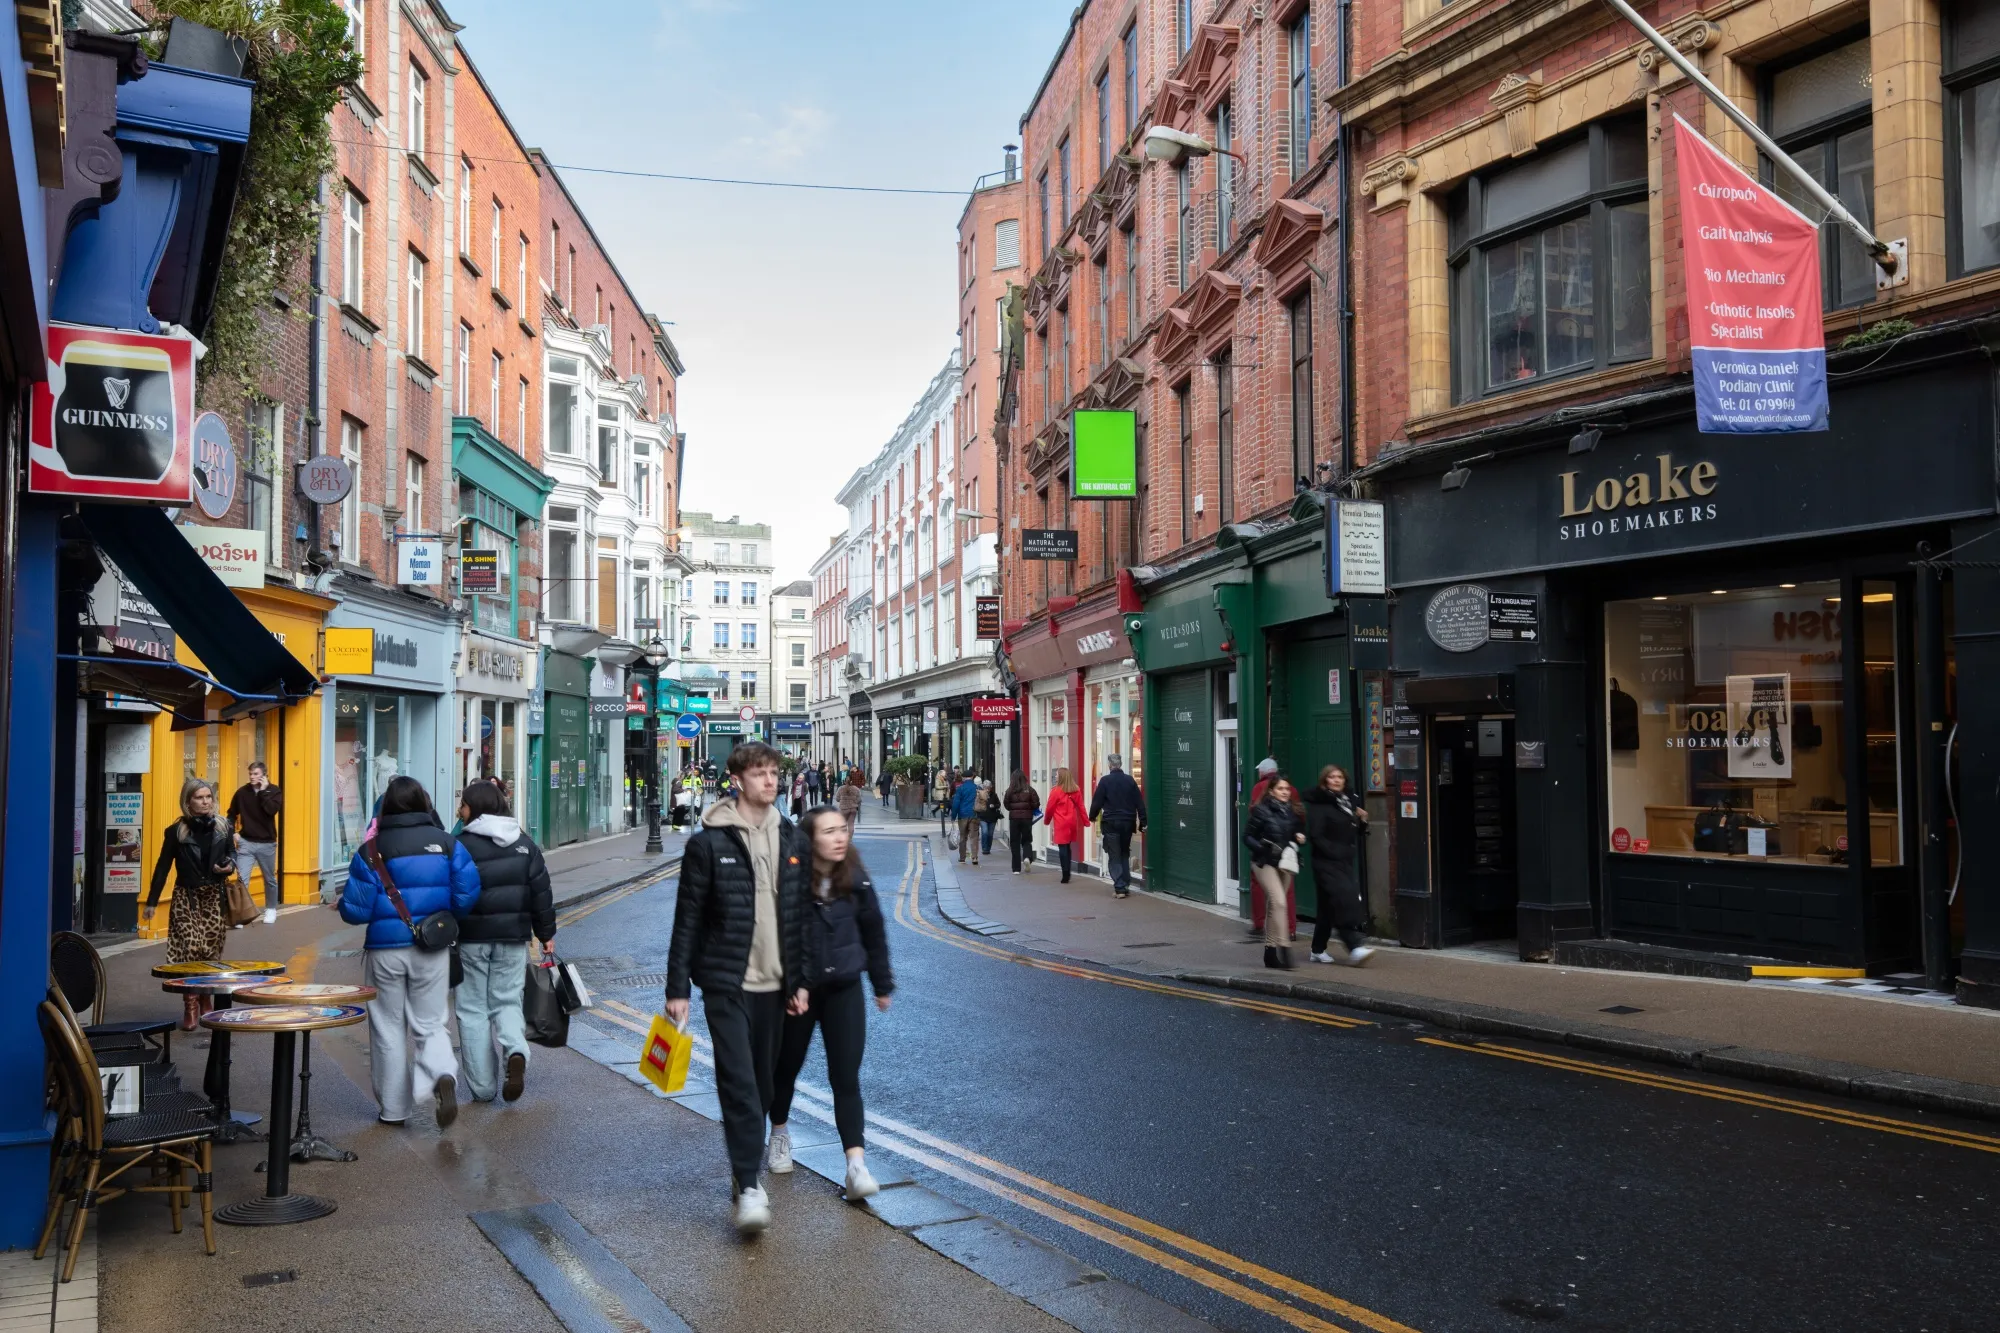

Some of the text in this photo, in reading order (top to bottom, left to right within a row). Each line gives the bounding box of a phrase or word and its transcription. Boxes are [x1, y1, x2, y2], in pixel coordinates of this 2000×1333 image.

[1700, 225, 1773, 245] Gait Analysis
[1725, 269, 1786, 285] Mechanics
[1710, 301, 1795, 319] Orthotic Insoles
[1711, 322, 1764, 340] Specialist
[1711, 361, 1799, 375] Veronica Daniels
[1719, 379, 1795, 395] Podiatry Clinic
[1718, 397, 1736, 410] Tel:
[1739, 398, 1750, 411] 01
[62, 408, 168, 432] GUINNESS
[200, 437, 229, 471] DRY
[311, 467, 341, 479] DRY
[1092, 482, 1118, 491] NATURAL
[1119, 482, 1132, 491] CUT
[1558, 453, 1719, 518] Loake
[1560, 503, 1717, 541] SHOEMAKERS
[413, 546, 428, 556] JoJo
[223, 565, 242, 573] Store
[409, 558, 431, 569] Maman
[412, 570, 427, 581] Bébé
[1440, 606, 1449, 614] OF
[1466, 603, 1481, 611] CARE
[1456, 597, 1478, 605] ASPECTS
[1160, 620, 1200, 640] WEIR SONS
[1354, 624, 1388, 636] Loake
[594, 703, 625, 712] ecco
[1175, 707, 1193, 724] Coming
[1668, 701, 1770, 732] Loake
[1177, 737, 1190, 752] Soon
[1368, 701, 1383, 788] TATTOO
[1666, 737, 1771, 748] SHOEMAKERS
